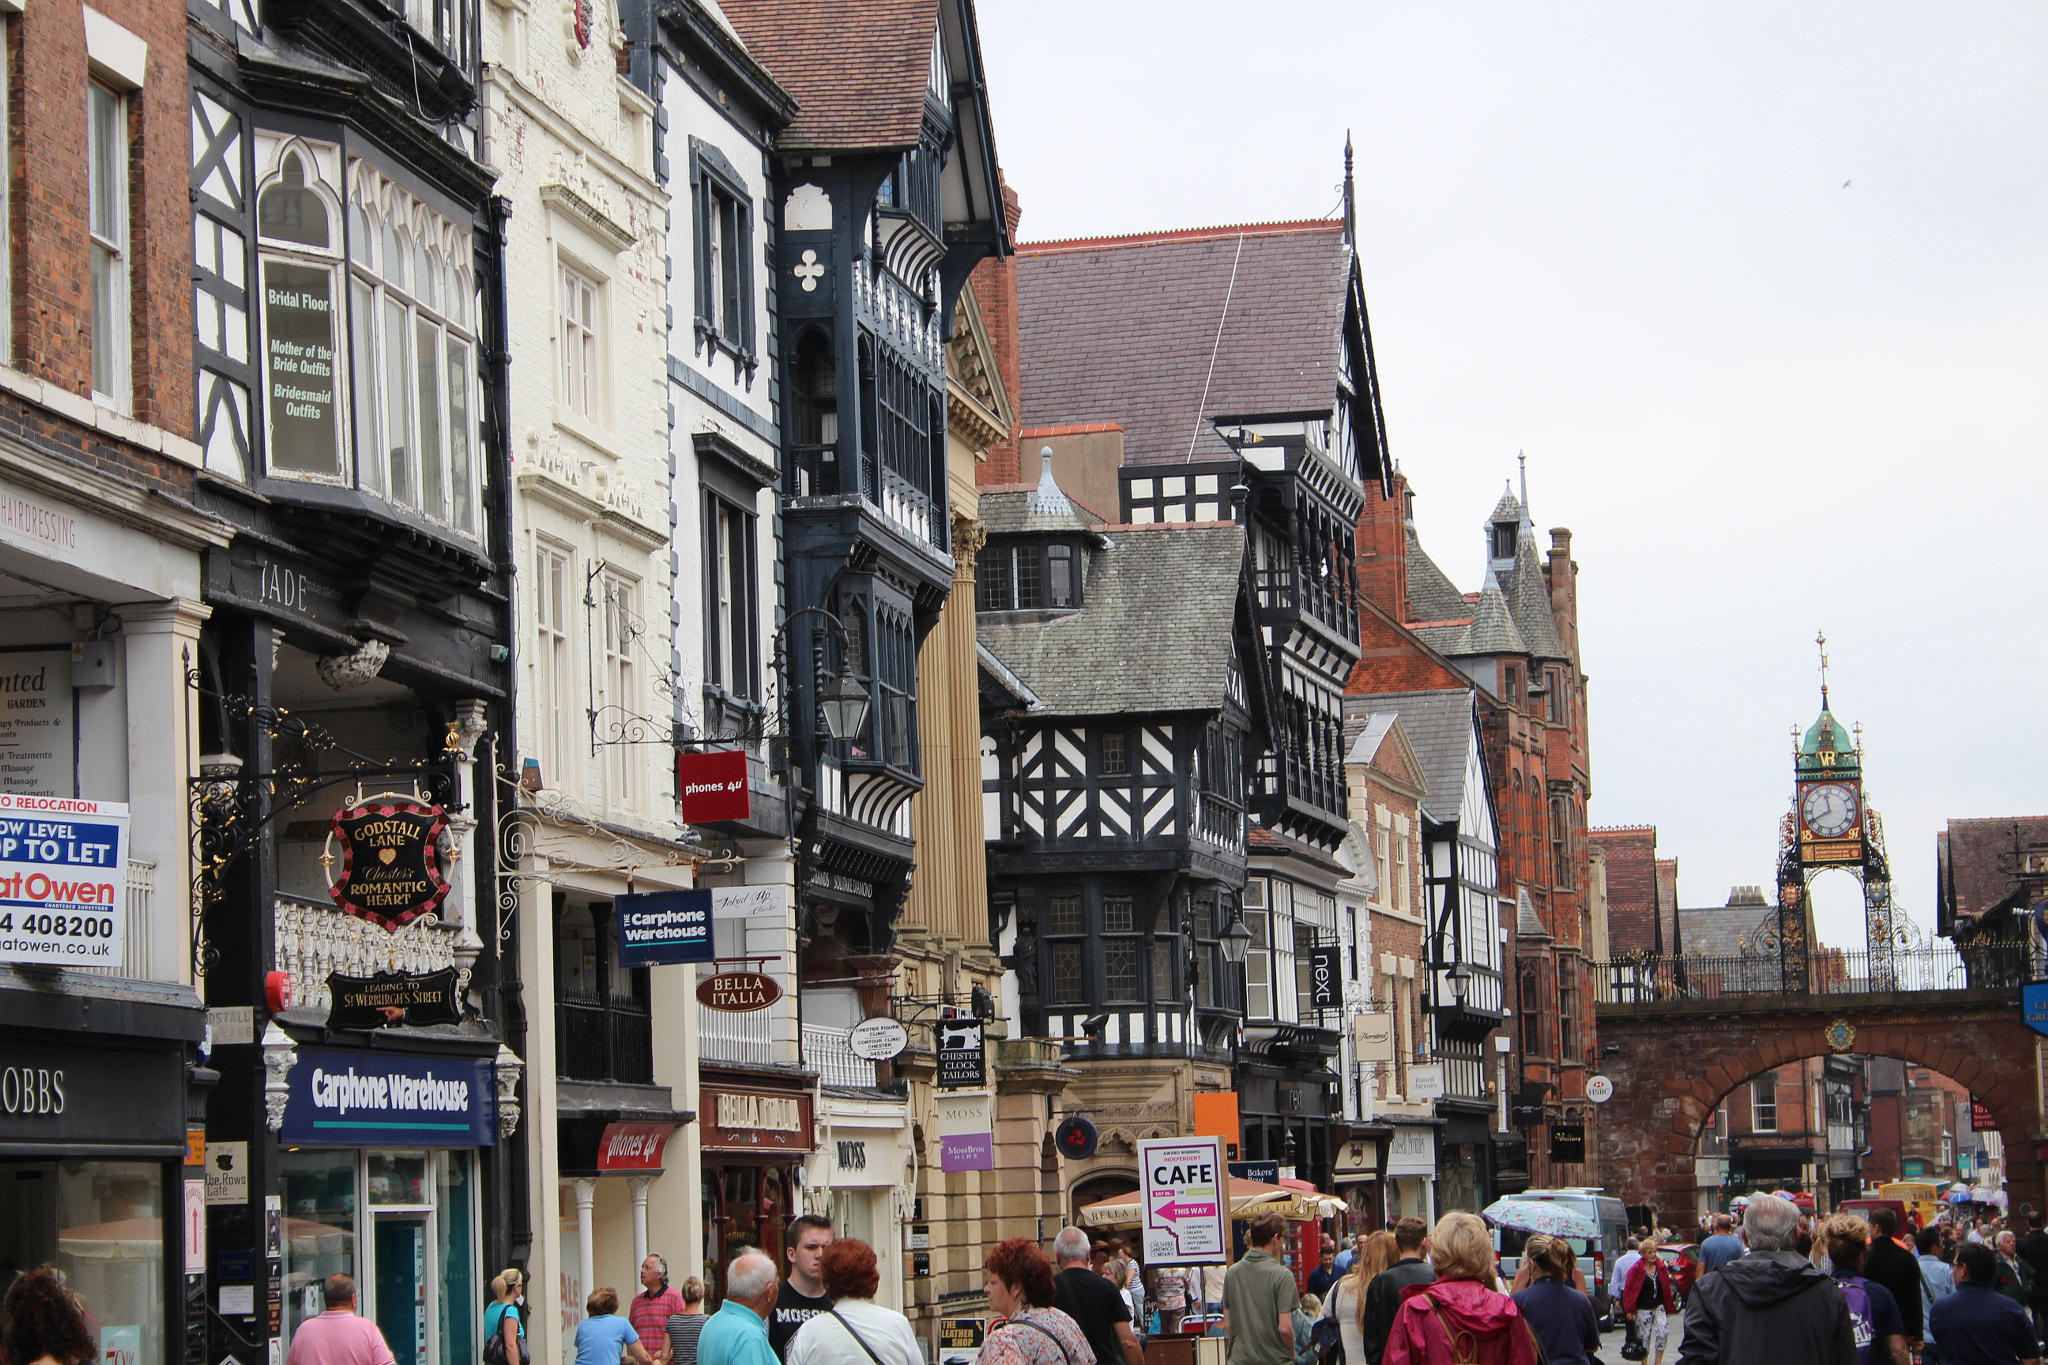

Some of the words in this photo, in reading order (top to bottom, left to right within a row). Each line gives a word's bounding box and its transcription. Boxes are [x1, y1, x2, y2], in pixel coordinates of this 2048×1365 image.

[268, 289, 299, 308] Bridal
[302, 294, 328, 311] Floor
[270, 339, 303, 356] Mother
[306, 345, 316, 358] of
[318, 346, 331, 360] the
[274, 357, 298, 372] Bride
[300, 360, 330, 376] Outfits
[274, 384, 331, 404] Bridesmaid
[286, 402, 320, 419] Outfits
[1, 494, 74, 548] HAIRDRESSING
[260, 560, 306, 612] JADE
[8, 698, 46, 709] GARDEN
[14, 718, 49, 727] Products
[53, 718, 61, 726] &
[8, 752, 52, 760] Treatments
[1, 765, 34, 774] Massage
[4, 778, 38, 787] Massage
[685, 782, 723, 796] phones
[727, 780, 742, 792] 4u
[0, 796, 11, 807] O
[16, 798, 97, 813] RELOCATION
[29, 823, 76, 839] LEVEL
[354, 820, 421, 840] GODSTALL
[1802, 830, 1812, 840] 18
[1848, 827, 1860, 839] 97
[370, 835, 405, 846] LANE
[0, 838, 17, 858] P
[24, 839, 59, 861] TO
[68, 842, 110, 864] LET
[362, 865, 414, 880] Chester's
[351, 881, 426, 895] ROMANTIC
[367, 894, 411, 906] HEART
[631, 910, 705, 926] Carphone
[22, 914, 113, 938] 408200
[626, 925, 706, 941] Warehouse
[0, 939, 109, 955] atowen.co.uk
[714, 976, 763, 990] BELLA
[1315, 954, 1330, 1003] next
[365, 983, 403, 992] LEADING
[356, 992, 410, 1006] WERBURGH'S
[413, 991, 442, 1004] STREET
[712, 990, 766, 1005] ITALIA
[940, 1052, 980, 1060] CHESTER
[946, 1062, 976, 1070] CLOCK
[942, 1071, 979, 1079] TAILORS
[2, 1067, 64, 1114] OBBS
[312, 1067, 388, 1114] Carphone
[388, 1072, 468, 1112] Warehouse
[717, 1094, 760, 1129] BELLA
[759, 1097, 801, 1132] ITALIA
[946, 1108, 983, 1120] MOSS
[1974, 1105, 1983, 1113] To
[607, 1127, 645, 1164] phones
[837, 1141, 866, 1169] MOSS
[222, 1173, 246, 1185] Rows
[1154, 1164, 1212, 1185] CAFE
[1092, 1209, 1128, 1221] BELLA
[942, 1329, 974, 1338] LEATHER
[952, 1338, 973, 1346] SHOP
